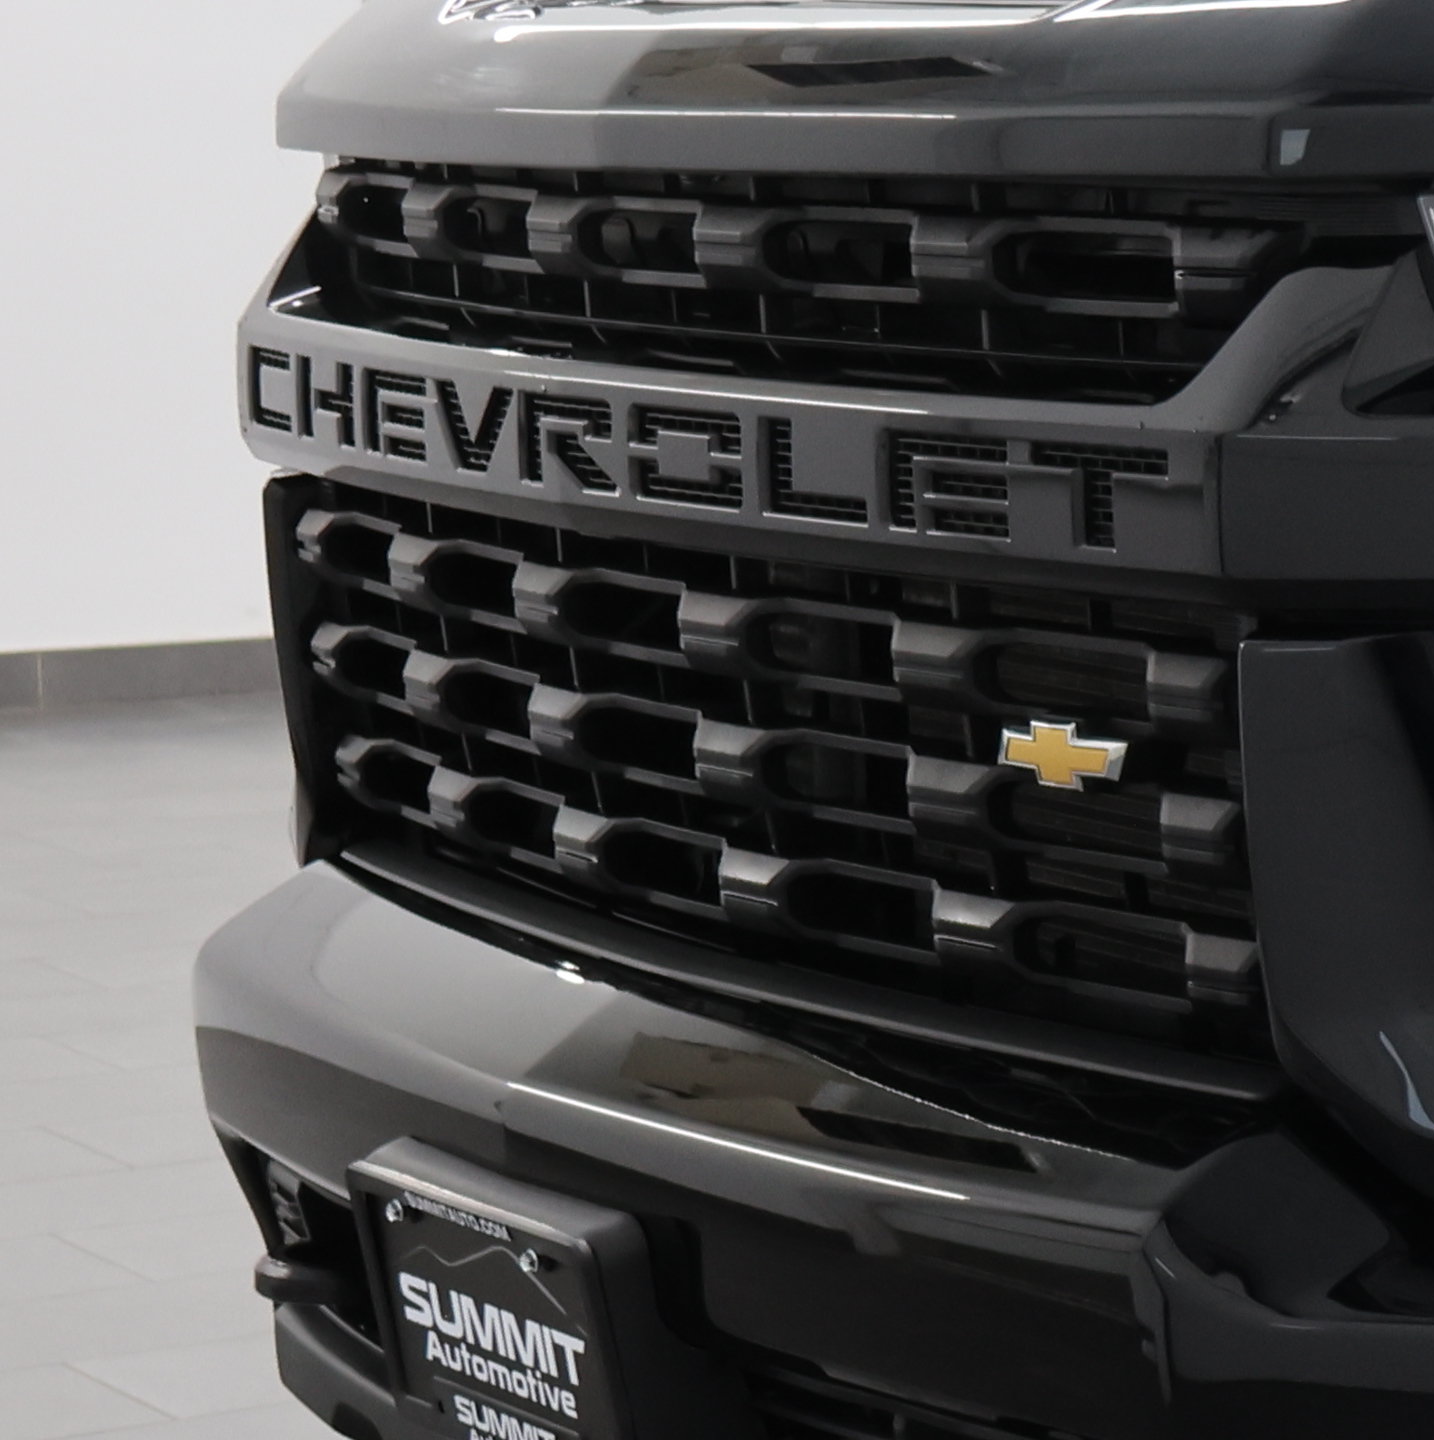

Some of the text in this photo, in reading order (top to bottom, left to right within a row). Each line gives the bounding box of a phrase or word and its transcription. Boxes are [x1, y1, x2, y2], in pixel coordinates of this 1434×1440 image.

[246, 345, 1169, 552] CHEVROLET
[398, 1271, 586, 1387] SUMMIT
[425, 1331, 578, 1420] Automotive
